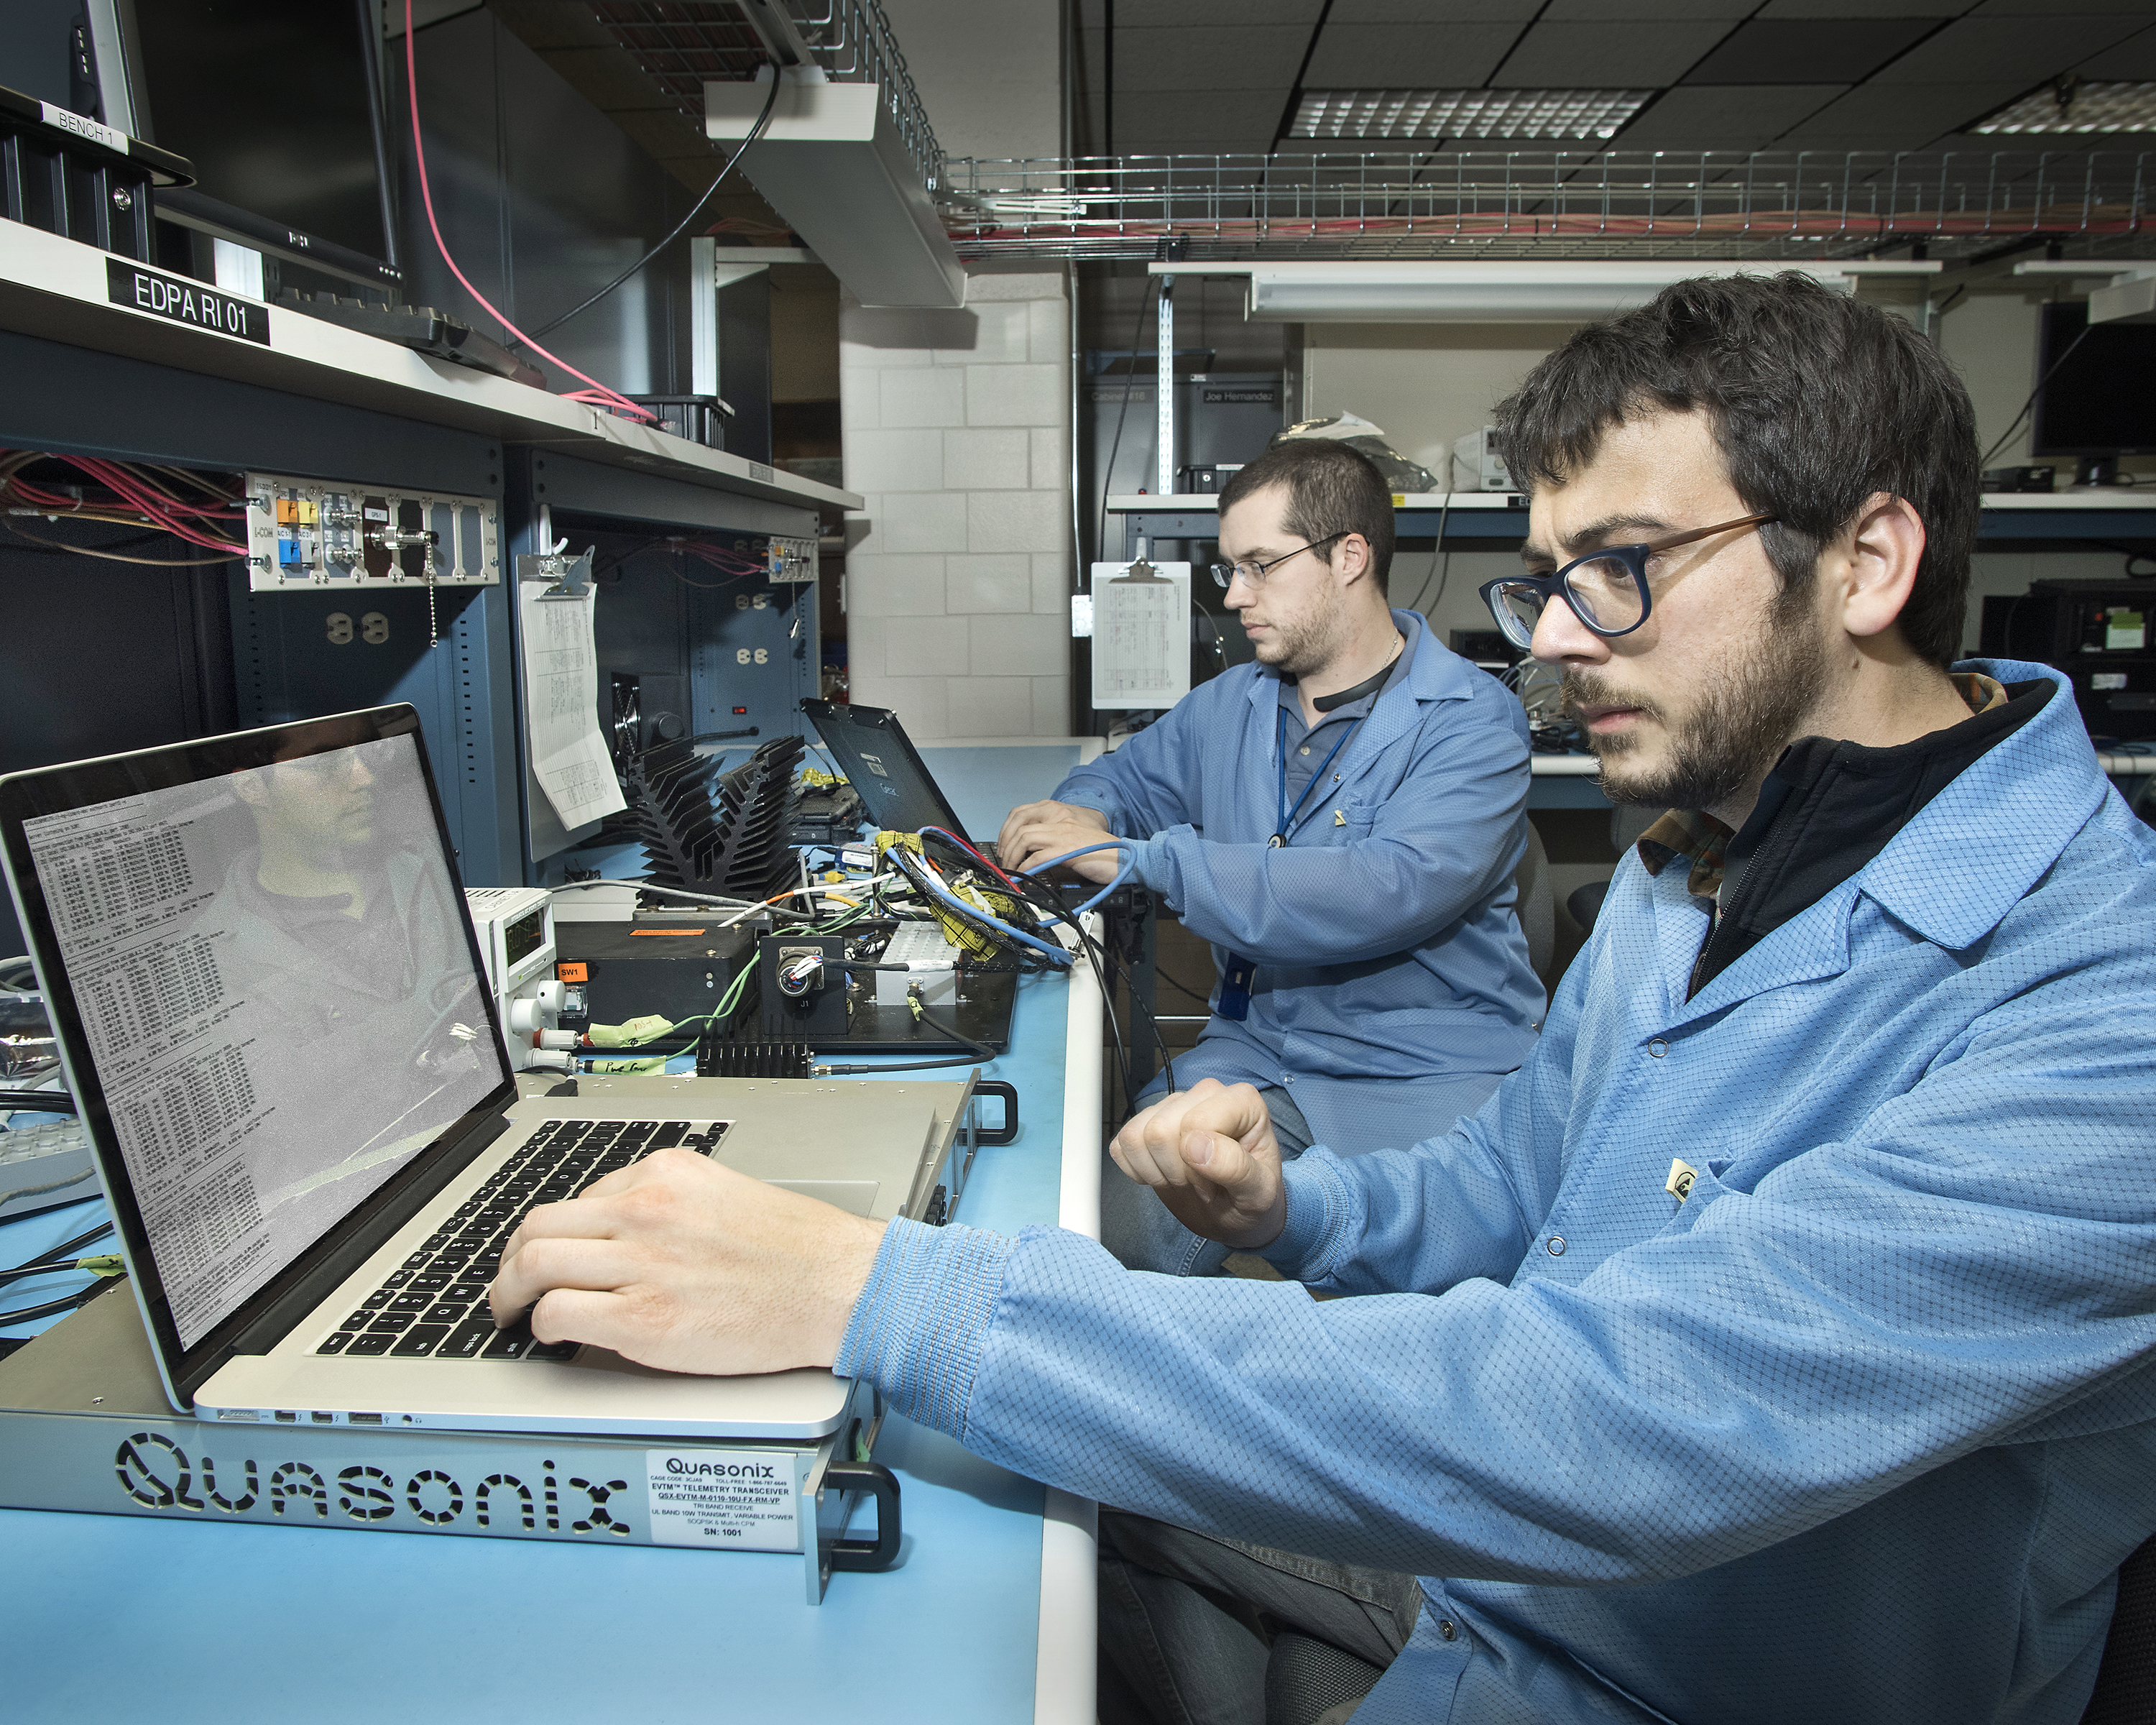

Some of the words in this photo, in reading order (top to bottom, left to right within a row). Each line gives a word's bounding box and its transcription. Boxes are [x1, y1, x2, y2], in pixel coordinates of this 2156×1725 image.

[59, 112, 103, 142] BENCH
[107, 131, 113, 145] 1
[134, 272, 197, 321] EDPA
[201, 293, 222, 328] RI
[226, 301, 247, 335] 01
[1206, 392, 1222, 401] Joe
[1224, 391, 1273, 401] Hernandez
[683, 1484, 730, 1494] TELEMETRY
[732, 1486, 789, 1496] TRANSCEIVER
[704, 1527, 720, 1536] SN:
[722, 1528, 742, 1537] 1001
